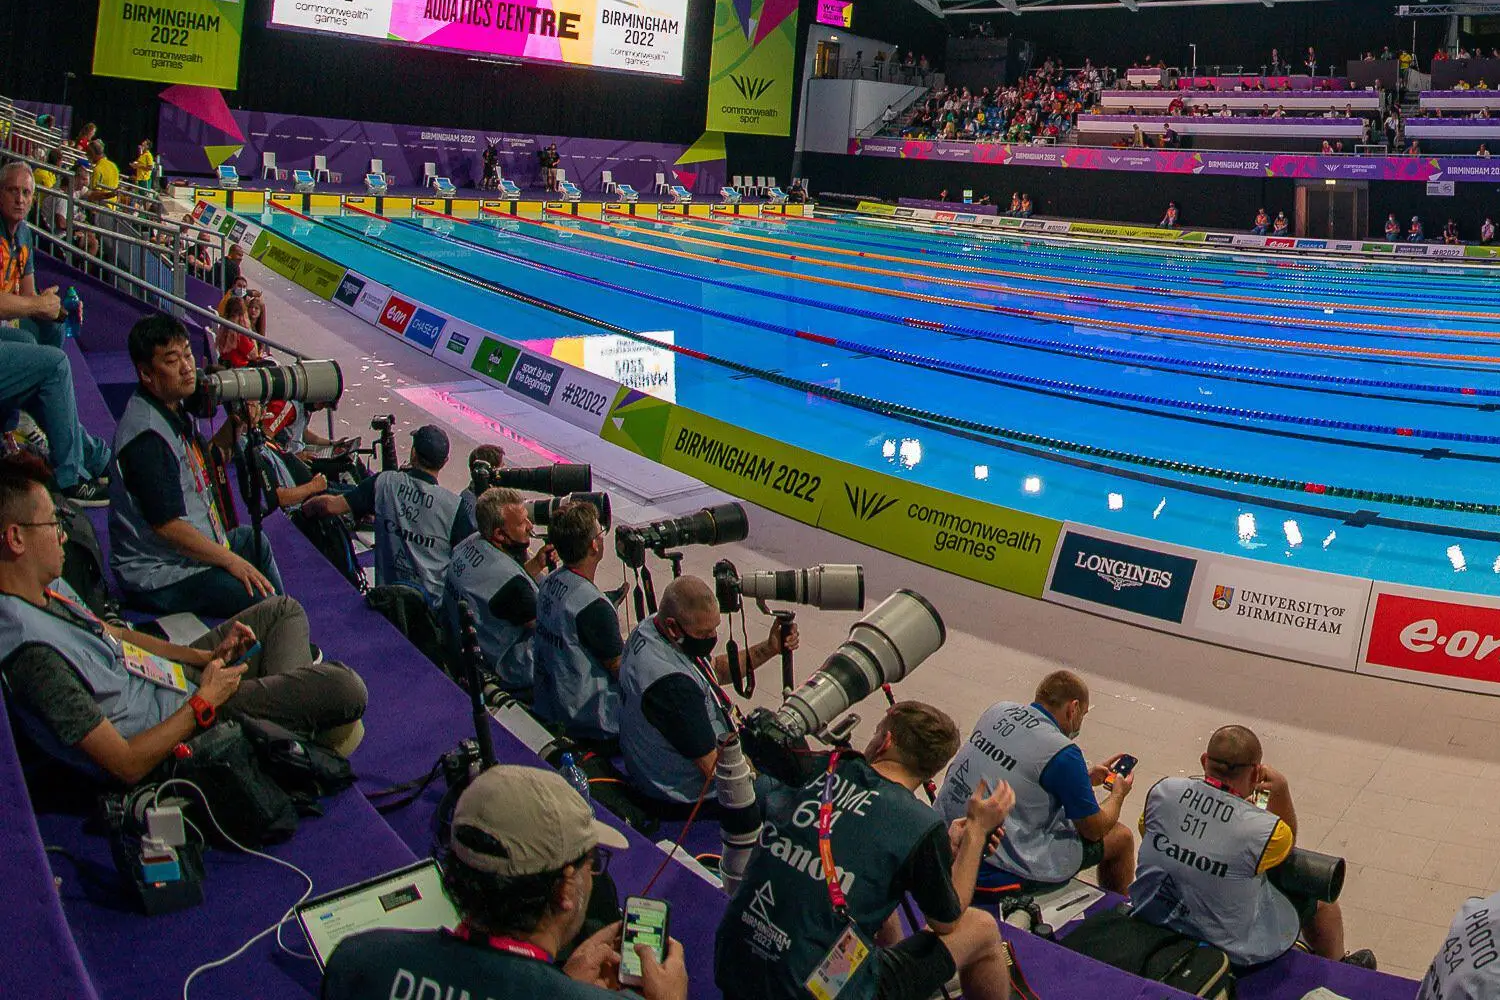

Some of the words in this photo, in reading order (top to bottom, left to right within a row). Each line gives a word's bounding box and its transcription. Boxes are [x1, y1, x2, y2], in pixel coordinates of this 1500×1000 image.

[122, 2, 220, 33] BIRMINGHAM
[295, 2, 369, 20] commonwealth
[314, 15, 348, 26] games
[496, 1, 581, 41] CENTRE
[601, 9, 679, 35] BIRMINGHAM
[150, 25, 190, 47] 2022
[624, 29, 655, 47] 2022
[132, 47, 204, 64] commonwealth
[151, 58, 184, 69] games
[721, 104, 778, 118] commonwealth
[739, 113, 760, 125] sport
[1244, 162, 1259, 170] 2022
[1447, 166, 1490, 176] BIRMINGHAM
[516, 370, 526, 382] the
[524, 373, 552, 395] beginning
[521, 363, 538, 375] sport
[536, 367, 543, 376] is
[542, 369, 554, 383] just
[561, 383, 607, 416] #B2022
[674, 427, 775, 486] BIRMINGHAM
[773, 464, 822, 503] 2022
[398, 484, 434, 509] PHOTO
[398, 504, 421, 523] 362
[907, 500, 1042, 555] commonwealth
[934, 531, 997, 562] games
[1074, 551, 1173, 589] LONGINES
[1241, 589, 1331, 616] UNIVERSITY
[1330, 606, 1346, 617] OF
[1237, 603, 1342, 635] BIRMINGHAM
[992, 718, 1016, 738] 510
[970, 730, 1017, 772] Canon
[792, 800, 842, 834] 64
[1179, 788, 1234, 822] PHOTO
[1180, 814, 1208, 840] 511
[758, 820, 855, 896] Canon
[1152, 833, 1228, 878] Canon
[753, 930, 772, 950] 2022
[1465, 908, 1498, 970] PHOTO
[1444, 936, 1464, 976] 434
